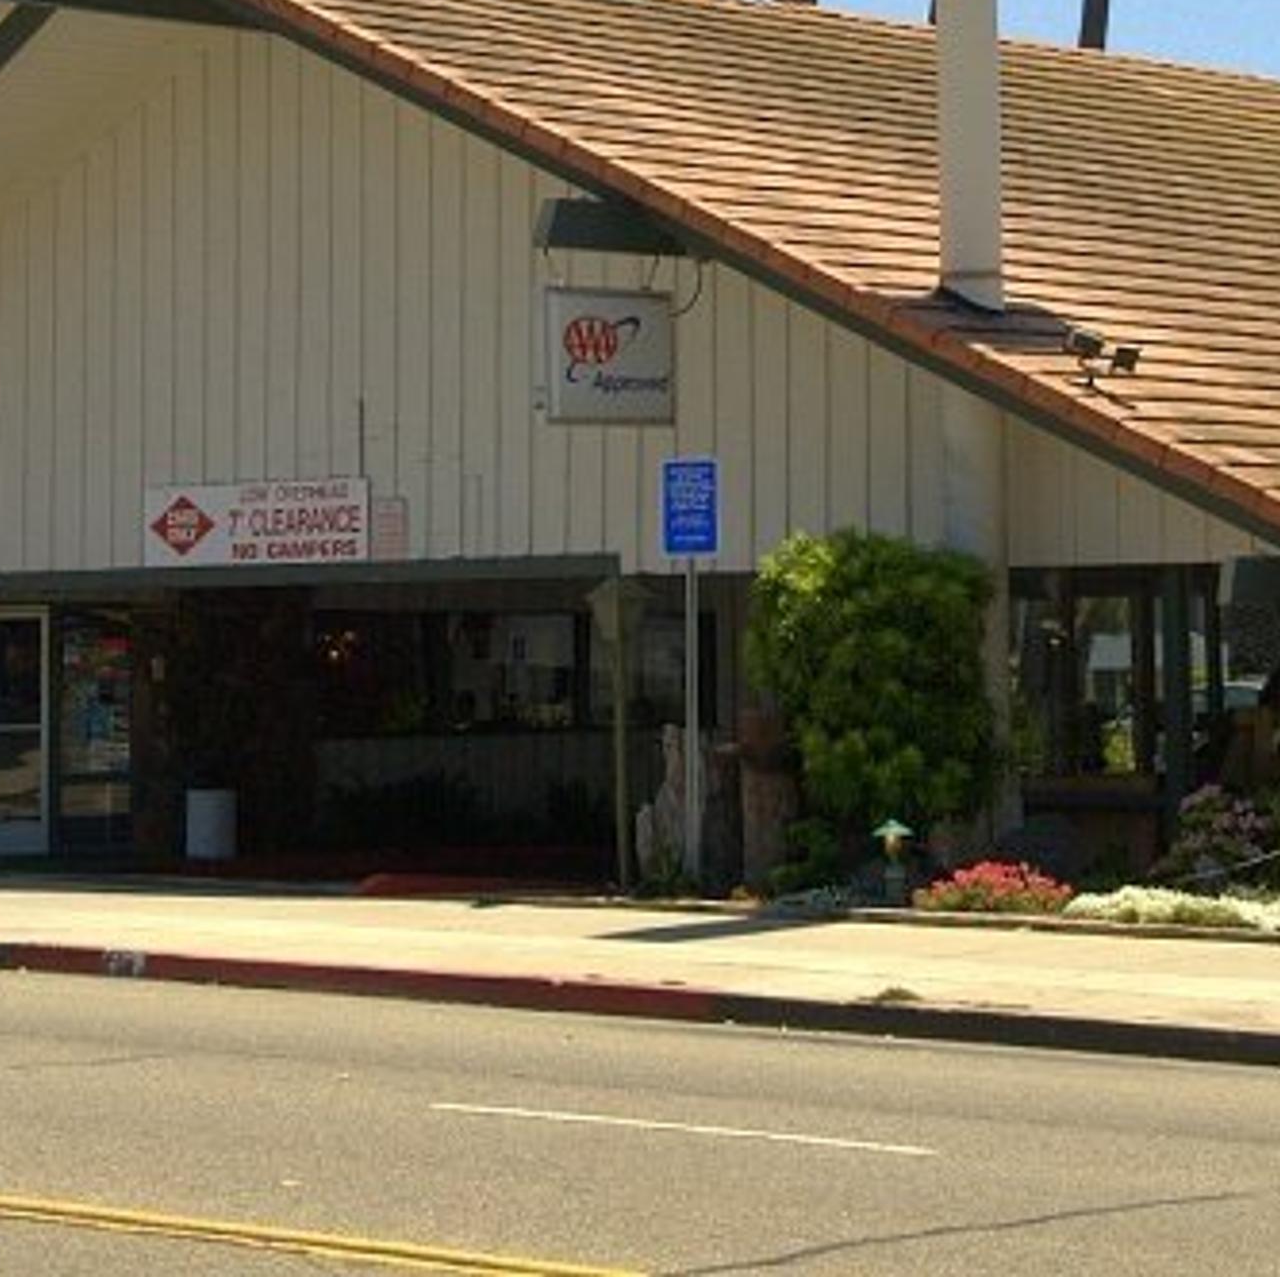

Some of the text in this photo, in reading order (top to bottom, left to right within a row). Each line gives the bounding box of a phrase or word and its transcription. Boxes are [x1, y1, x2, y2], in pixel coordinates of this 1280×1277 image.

[248, 504, 362, 537] CLEARANCE
[231, 539, 358, 560] NO CAMPERS
